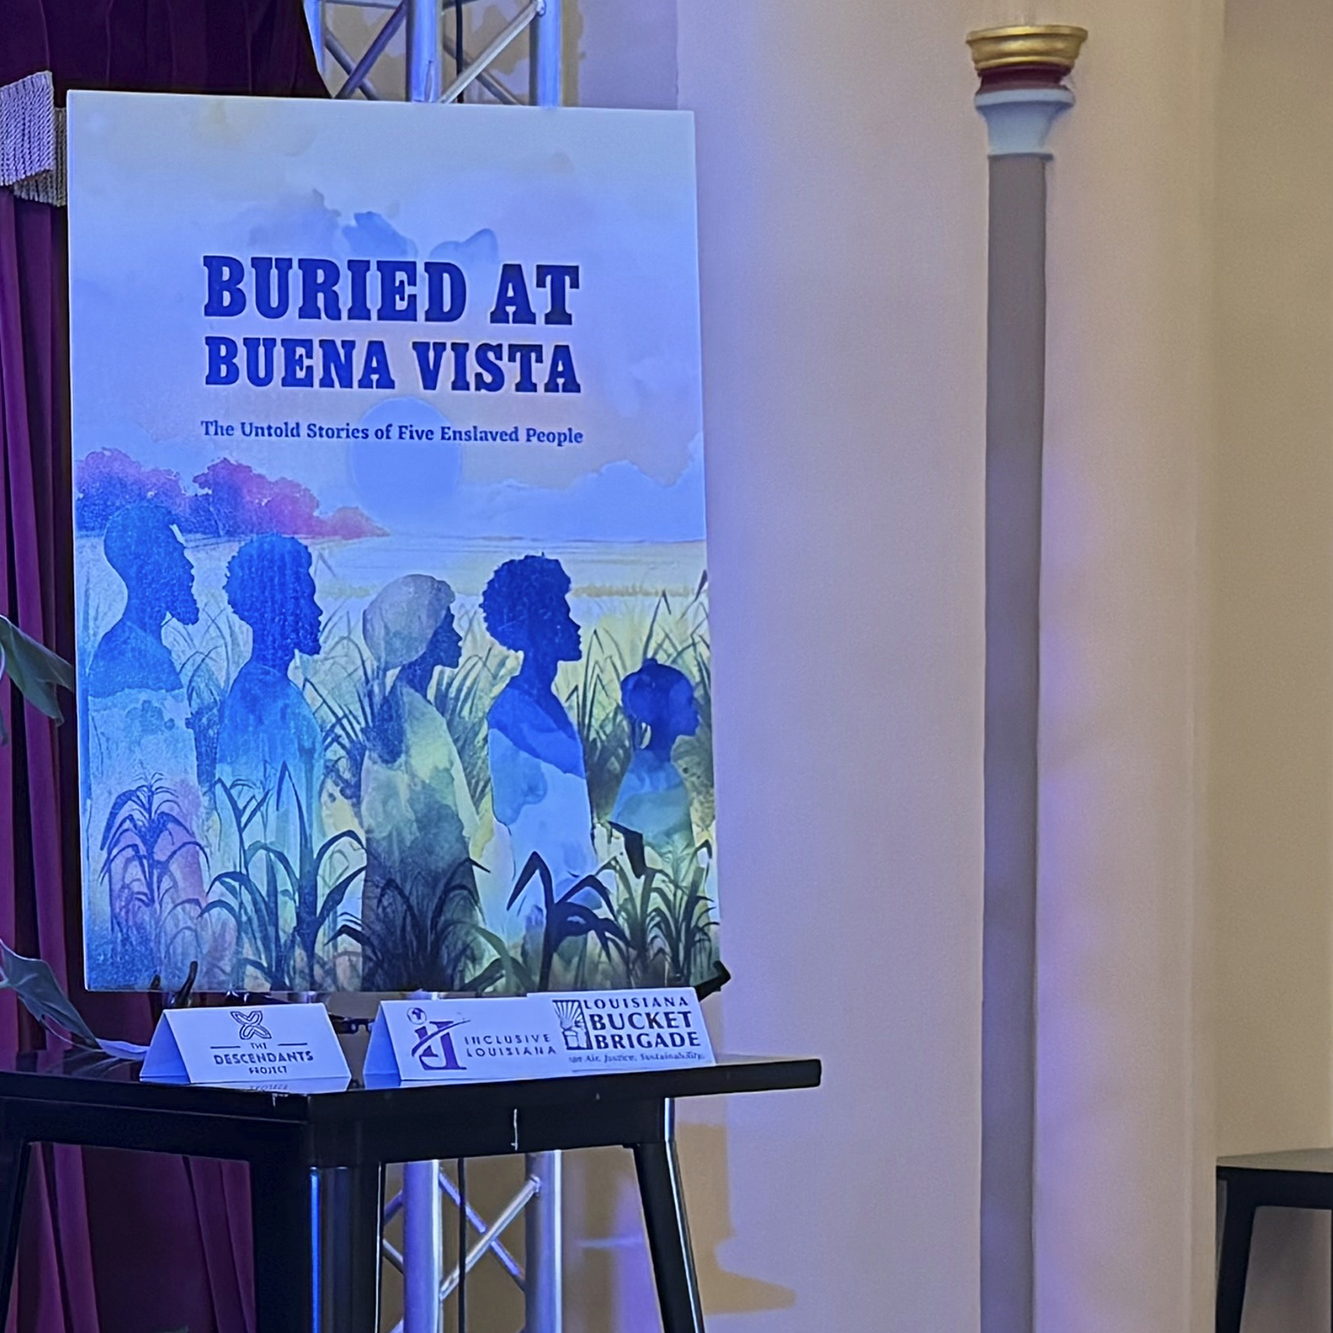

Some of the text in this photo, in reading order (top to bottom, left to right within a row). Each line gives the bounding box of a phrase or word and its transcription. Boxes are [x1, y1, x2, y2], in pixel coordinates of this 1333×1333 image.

[203, 255, 580, 325] BURIED AT
[204, 336, 581, 393] BUENA VISTA
[200, 420, 584, 447] The Untold Stories of Five Enslaved People
[583, 996, 689, 1010] LOUISIANA
[588, 1010, 692, 1031] BUCKET
[250, 1042, 268, 1050] THE
[464, 1033, 551, 1045] INCLUSIVE
[594, 1031, 701, 1050] BRIGADE
[213, 1050, 314, 1065] DESCENDANTS
[466, 1046, 557, 1058] LOUISIANA
[248, 1065, 288, 1075] PROJECT
